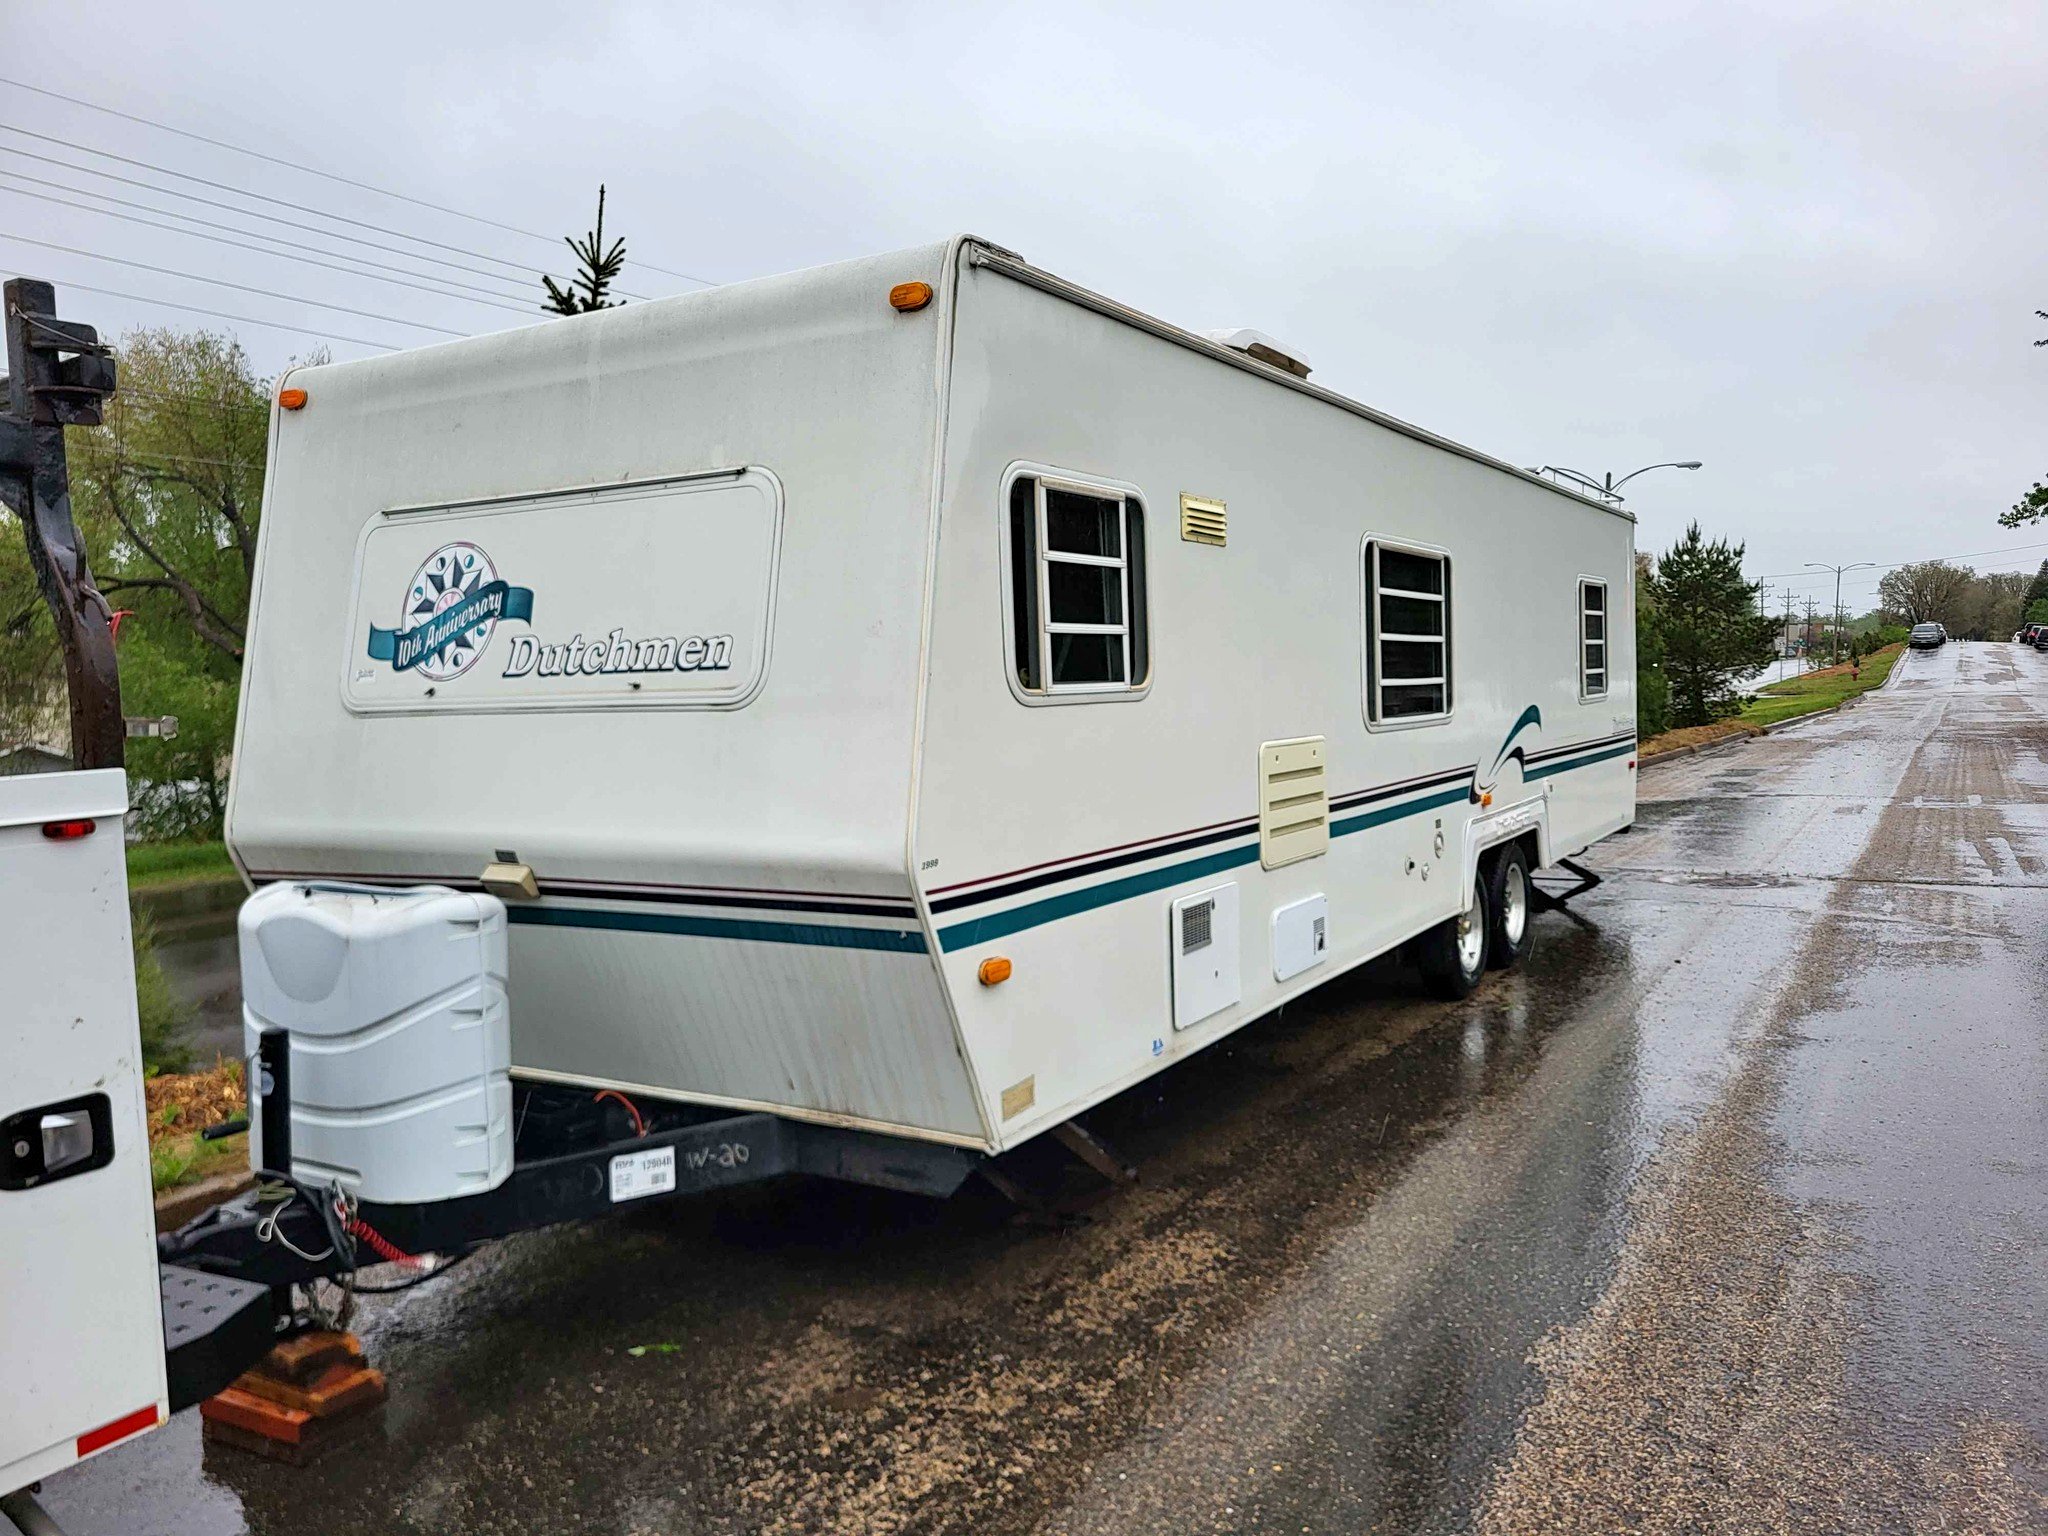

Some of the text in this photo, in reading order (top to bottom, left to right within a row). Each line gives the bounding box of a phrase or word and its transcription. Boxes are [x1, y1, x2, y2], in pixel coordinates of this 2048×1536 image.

[397, 590, 503, 667] 10th Anniversary
[502, 627, 733, 677] Dutchmen
